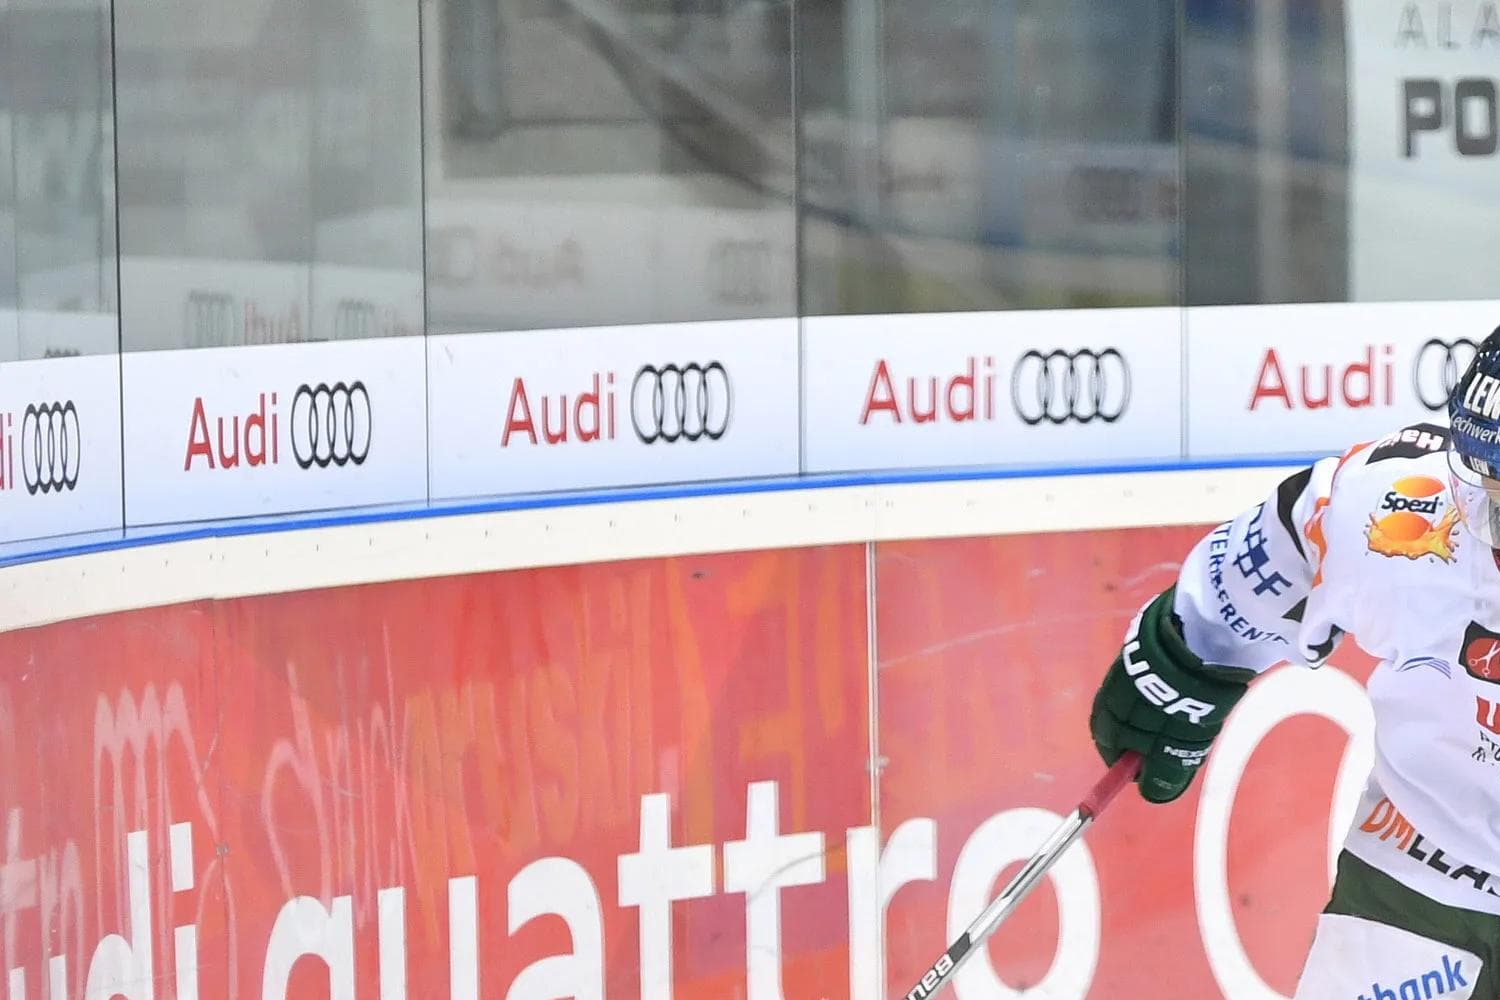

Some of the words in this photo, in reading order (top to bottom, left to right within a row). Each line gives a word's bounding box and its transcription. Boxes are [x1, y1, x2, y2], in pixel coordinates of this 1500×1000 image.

[500, 372, 617, 449] Audi
[860, 357, 996, 425] Audi
[1249, 346, 1394, 411] Audi
[184, 394, 278, 471] Audi
[1469, 455, 1490, 476] LEW
[1381, 491, 1440, 515] Spezi
